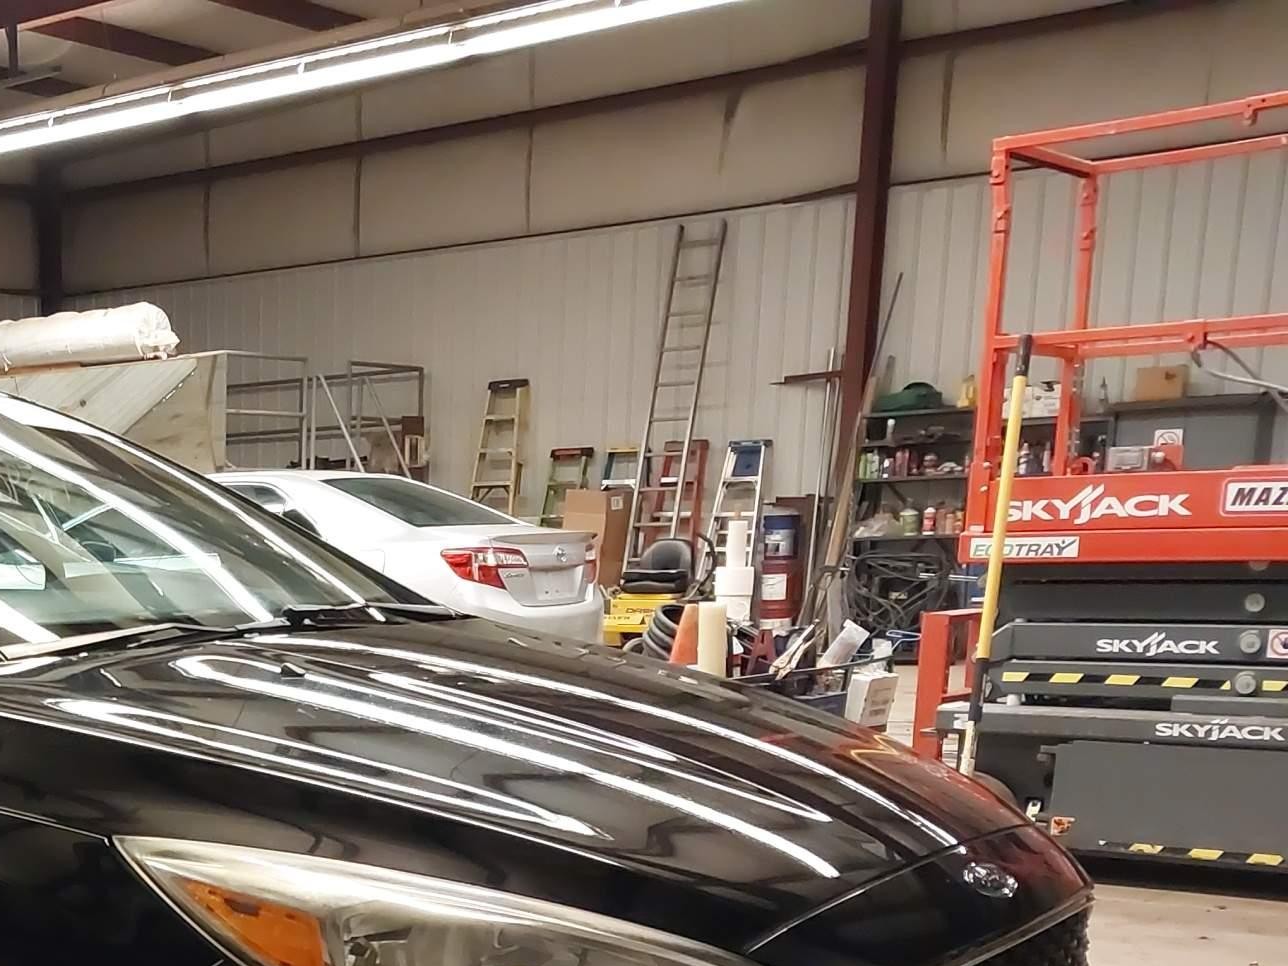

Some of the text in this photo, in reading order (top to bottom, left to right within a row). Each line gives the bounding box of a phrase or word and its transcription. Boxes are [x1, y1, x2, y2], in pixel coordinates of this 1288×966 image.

[1007, 483, 1192, 525] SKYJACK
[1230, 487, 1288, 506] MAZ
[1096, 631, 1219, 657] SKYJACK
[1155, 718, 1285, 742] SKYJACK
